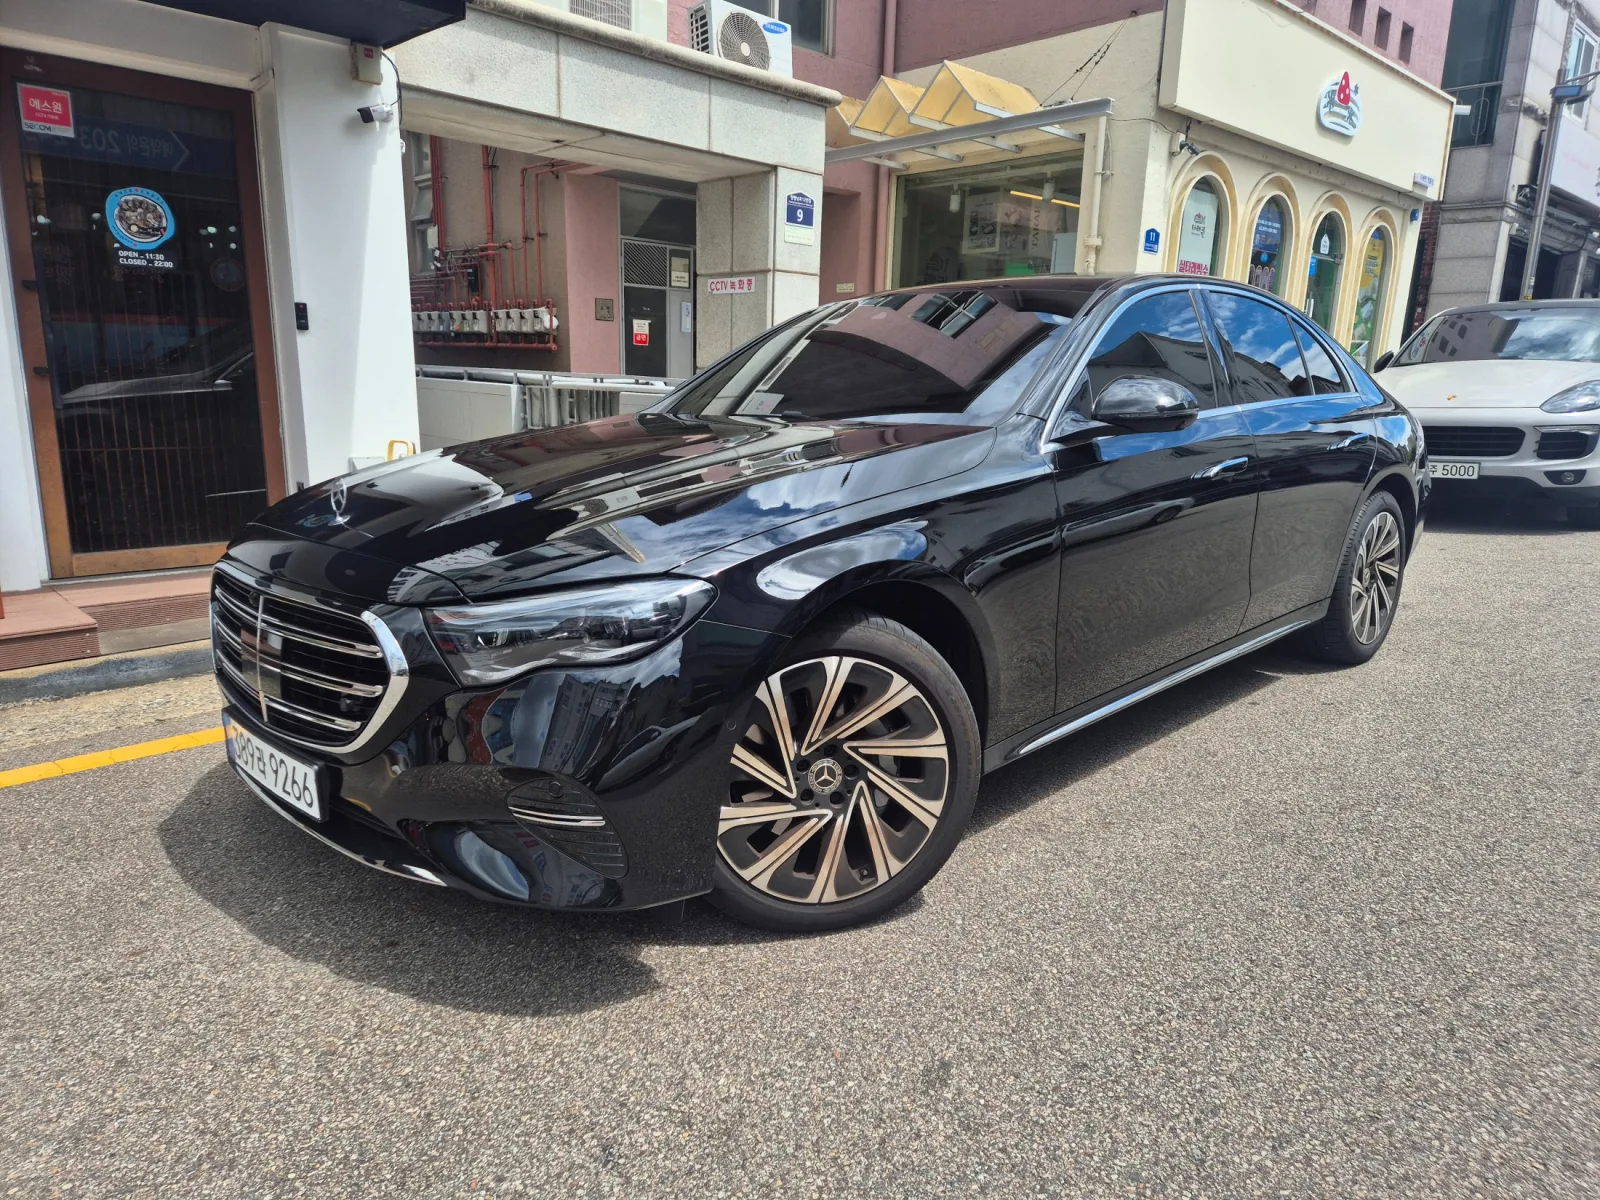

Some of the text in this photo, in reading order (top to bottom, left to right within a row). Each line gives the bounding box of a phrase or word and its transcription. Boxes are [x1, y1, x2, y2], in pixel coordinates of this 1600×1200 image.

[29, 98, 62, 113] 에스원
[24, 122, 51, 131] SECOM
[796, 209, 803, 222] 9
[1150, 232, 1156, 241] 11
[119, 258, 147, 266] CLOSED
[710, 281, 728, 291] CCTV
[1442, 465, 1475, 477] 5000
[269, 753, 313, 808] 9266
